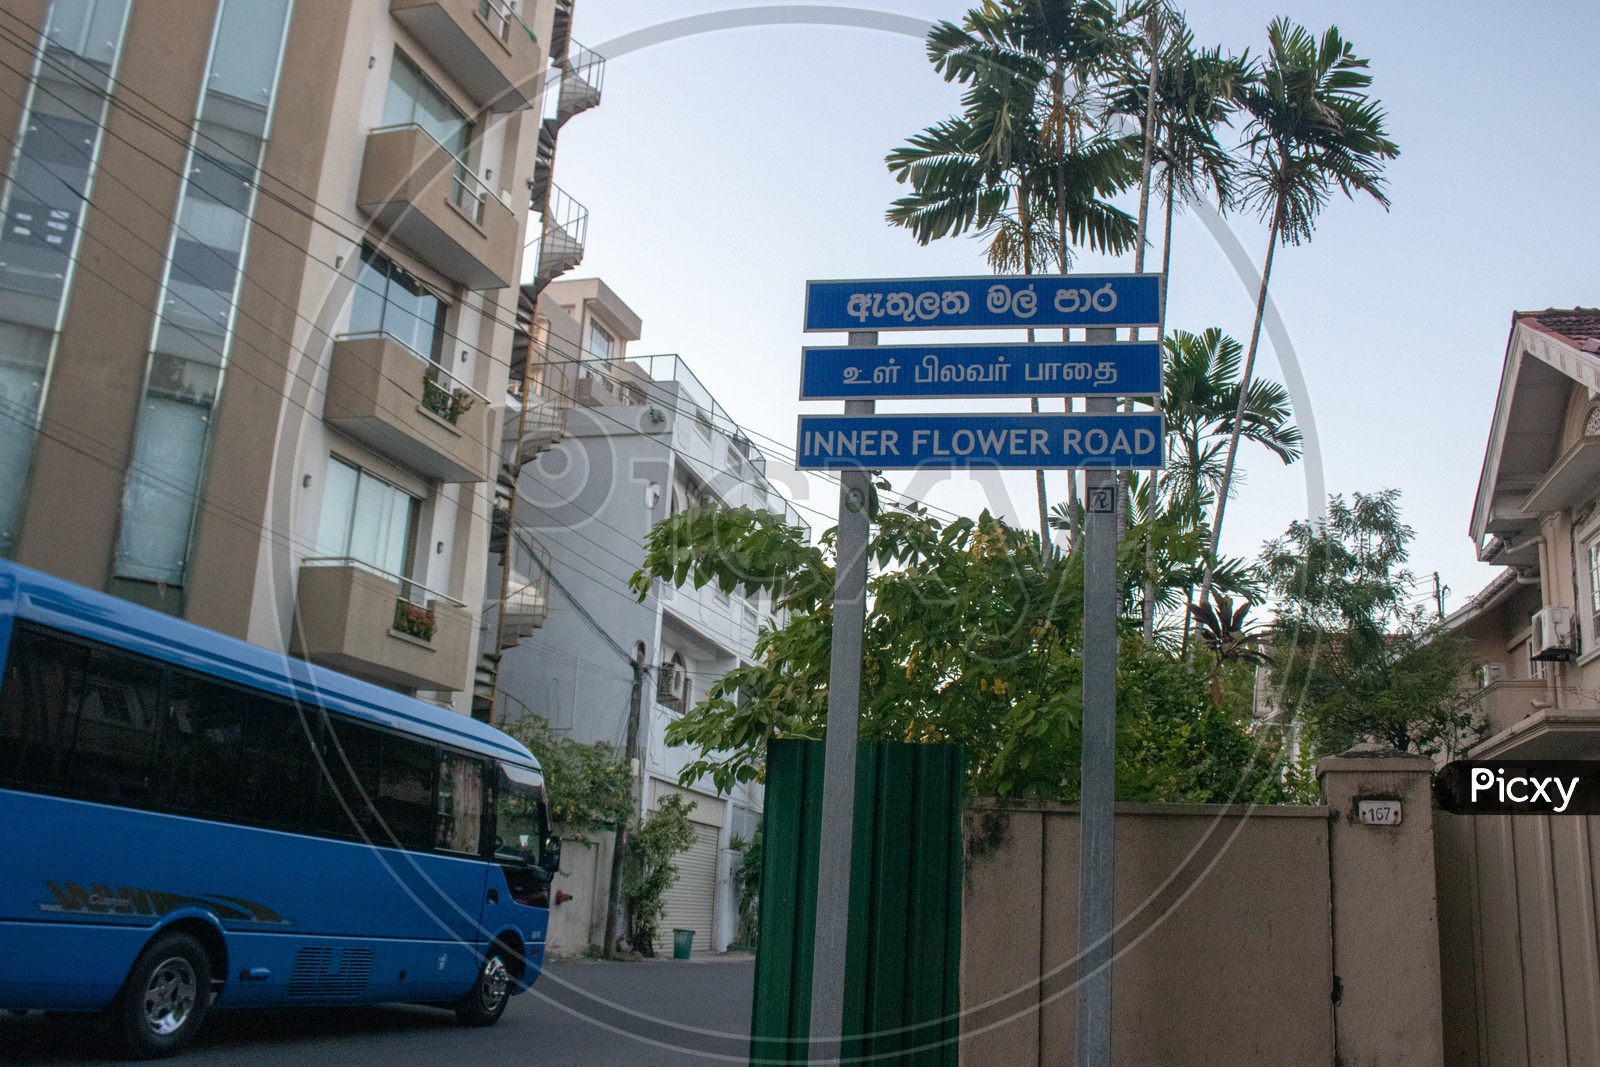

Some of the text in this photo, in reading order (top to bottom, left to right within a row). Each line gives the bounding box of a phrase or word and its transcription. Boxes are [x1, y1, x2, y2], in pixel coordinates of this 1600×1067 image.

[847, 283, 1118, 322] ඇතුලත මල් පාර
[843, 355, 1118, 387] உள் பிலவர் பாதை
[804, 428, 1156, 456] INNER FLOWER ROAD
[1368, 806, 1391, 822] 167
